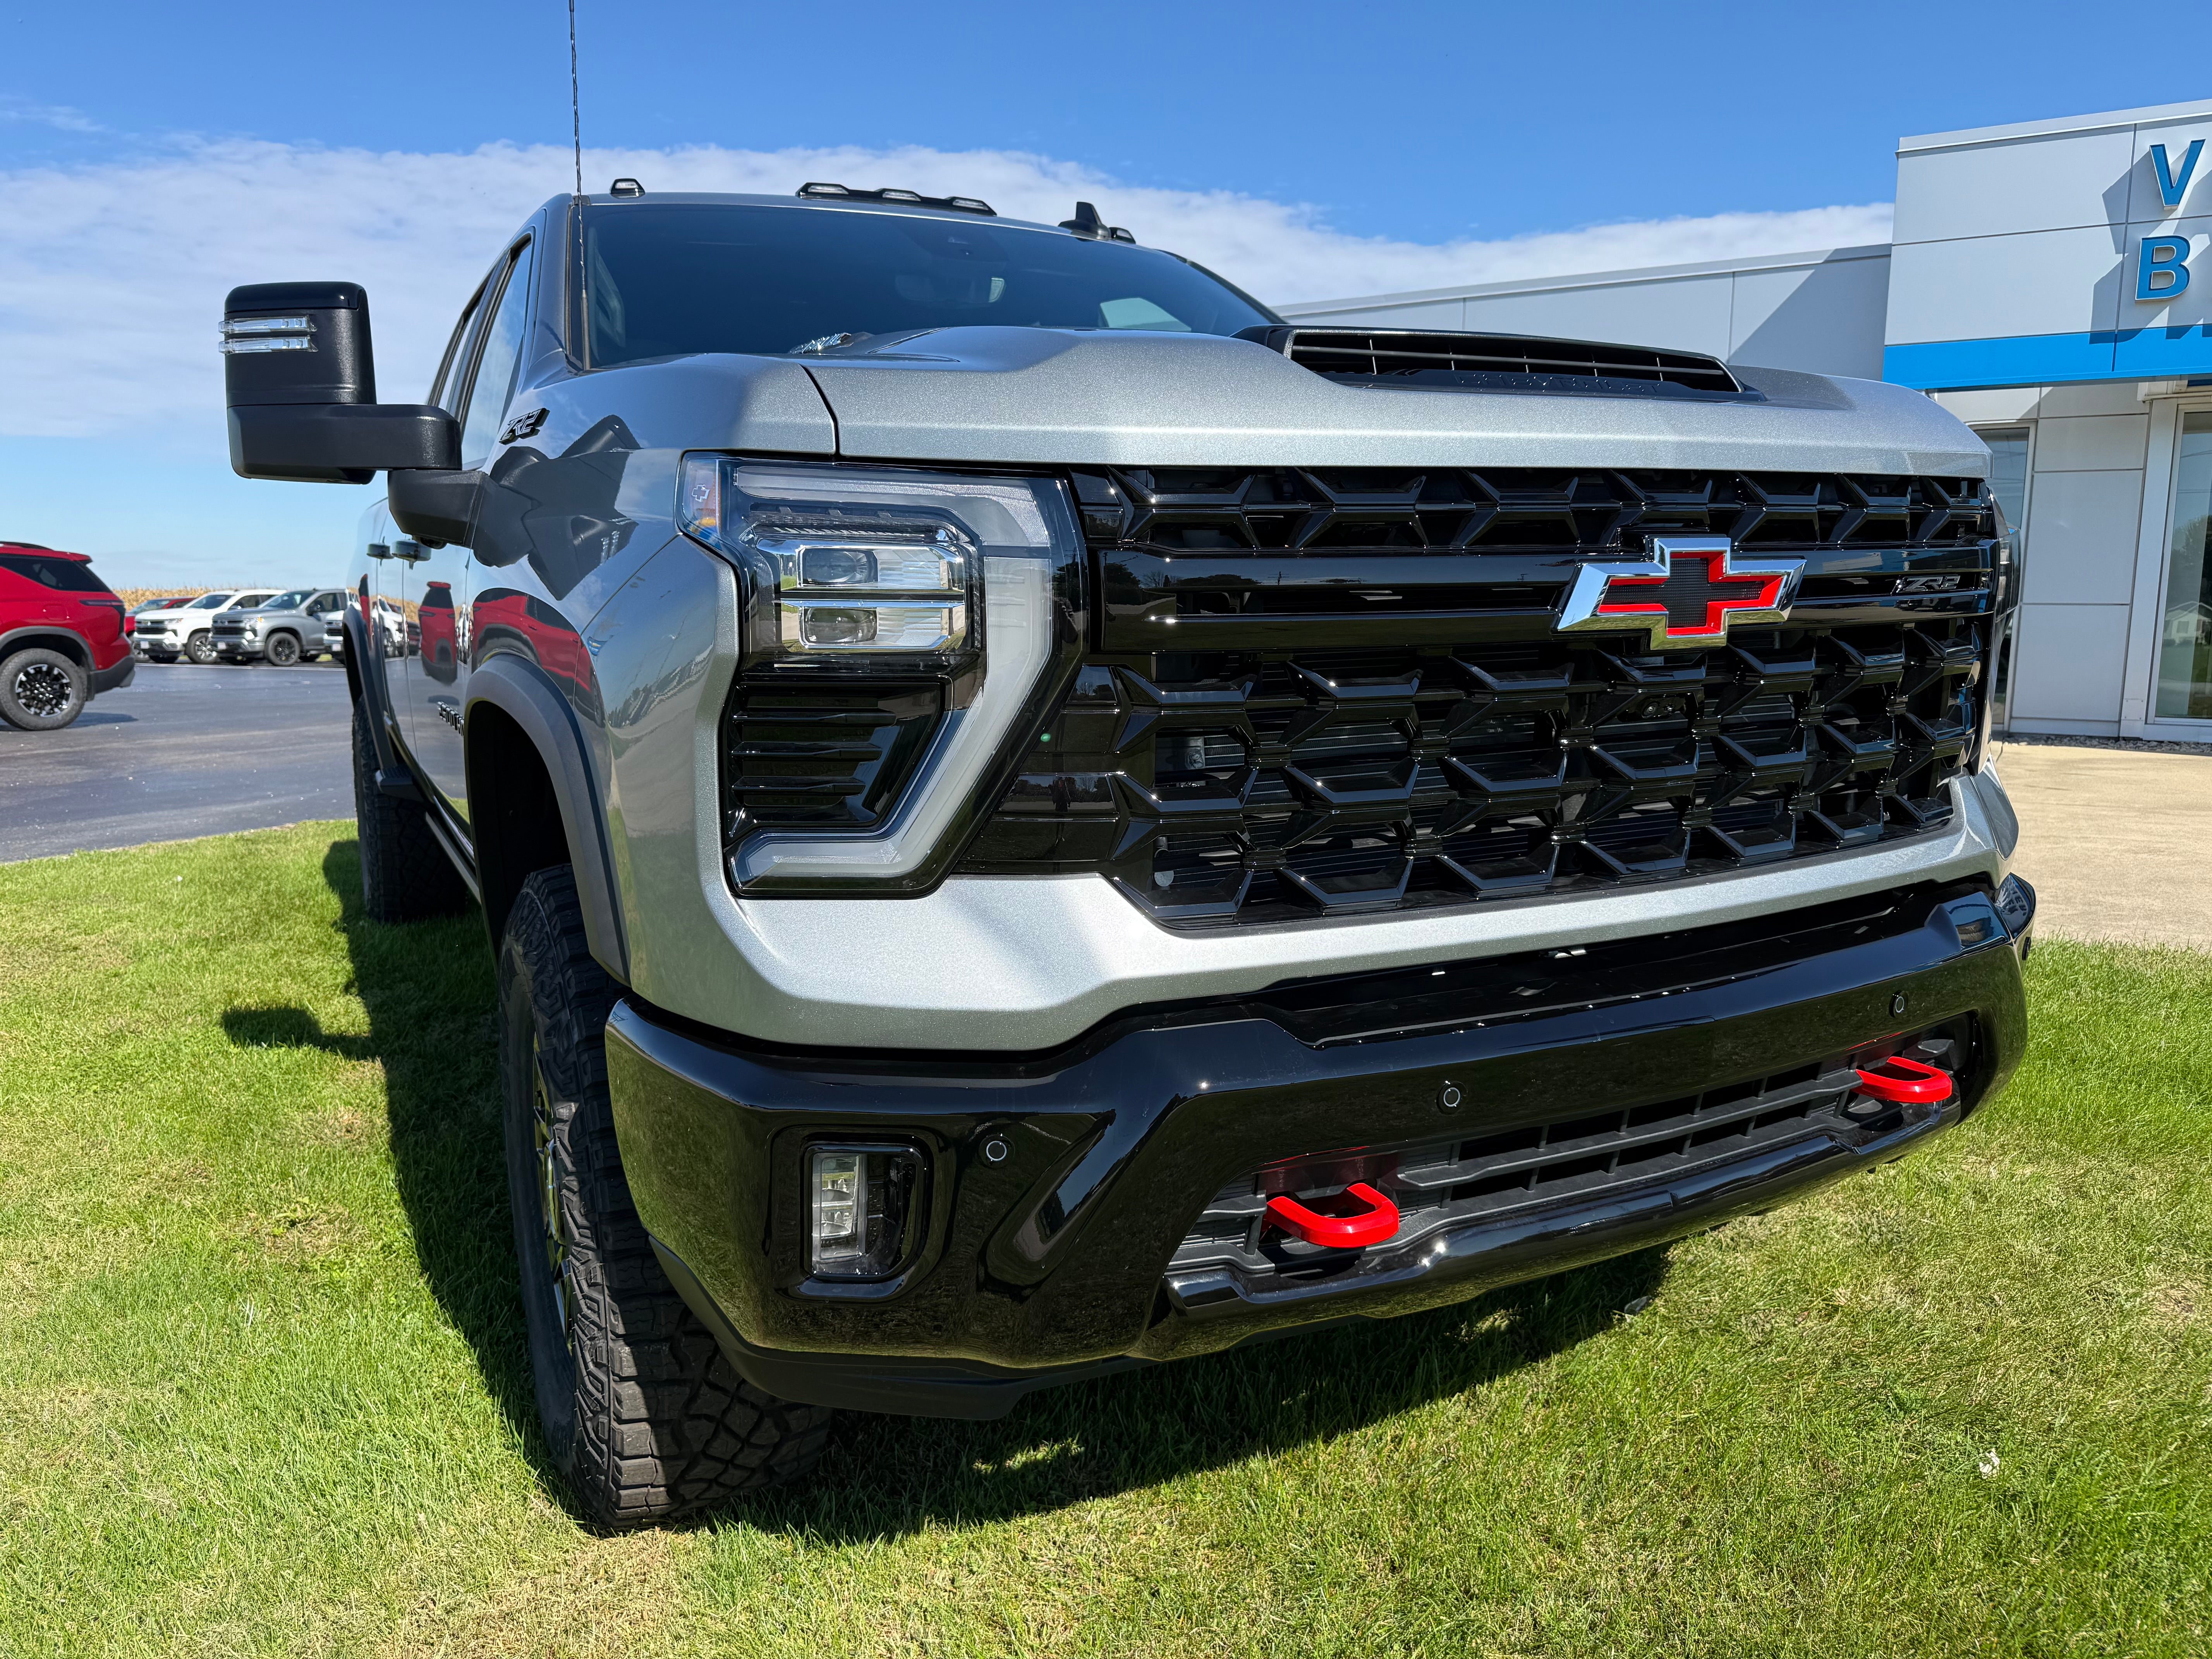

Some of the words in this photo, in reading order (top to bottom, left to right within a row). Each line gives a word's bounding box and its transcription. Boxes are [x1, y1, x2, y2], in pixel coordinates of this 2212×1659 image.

[2149, 139, 2206, 210] V
[2135, 235, 2190, 302] B
[1453, 373, 1660, 393] CHEVROLET
[499, 408, 547, 443] ZR2
[1901, 574, 1961, 592] ZR2
